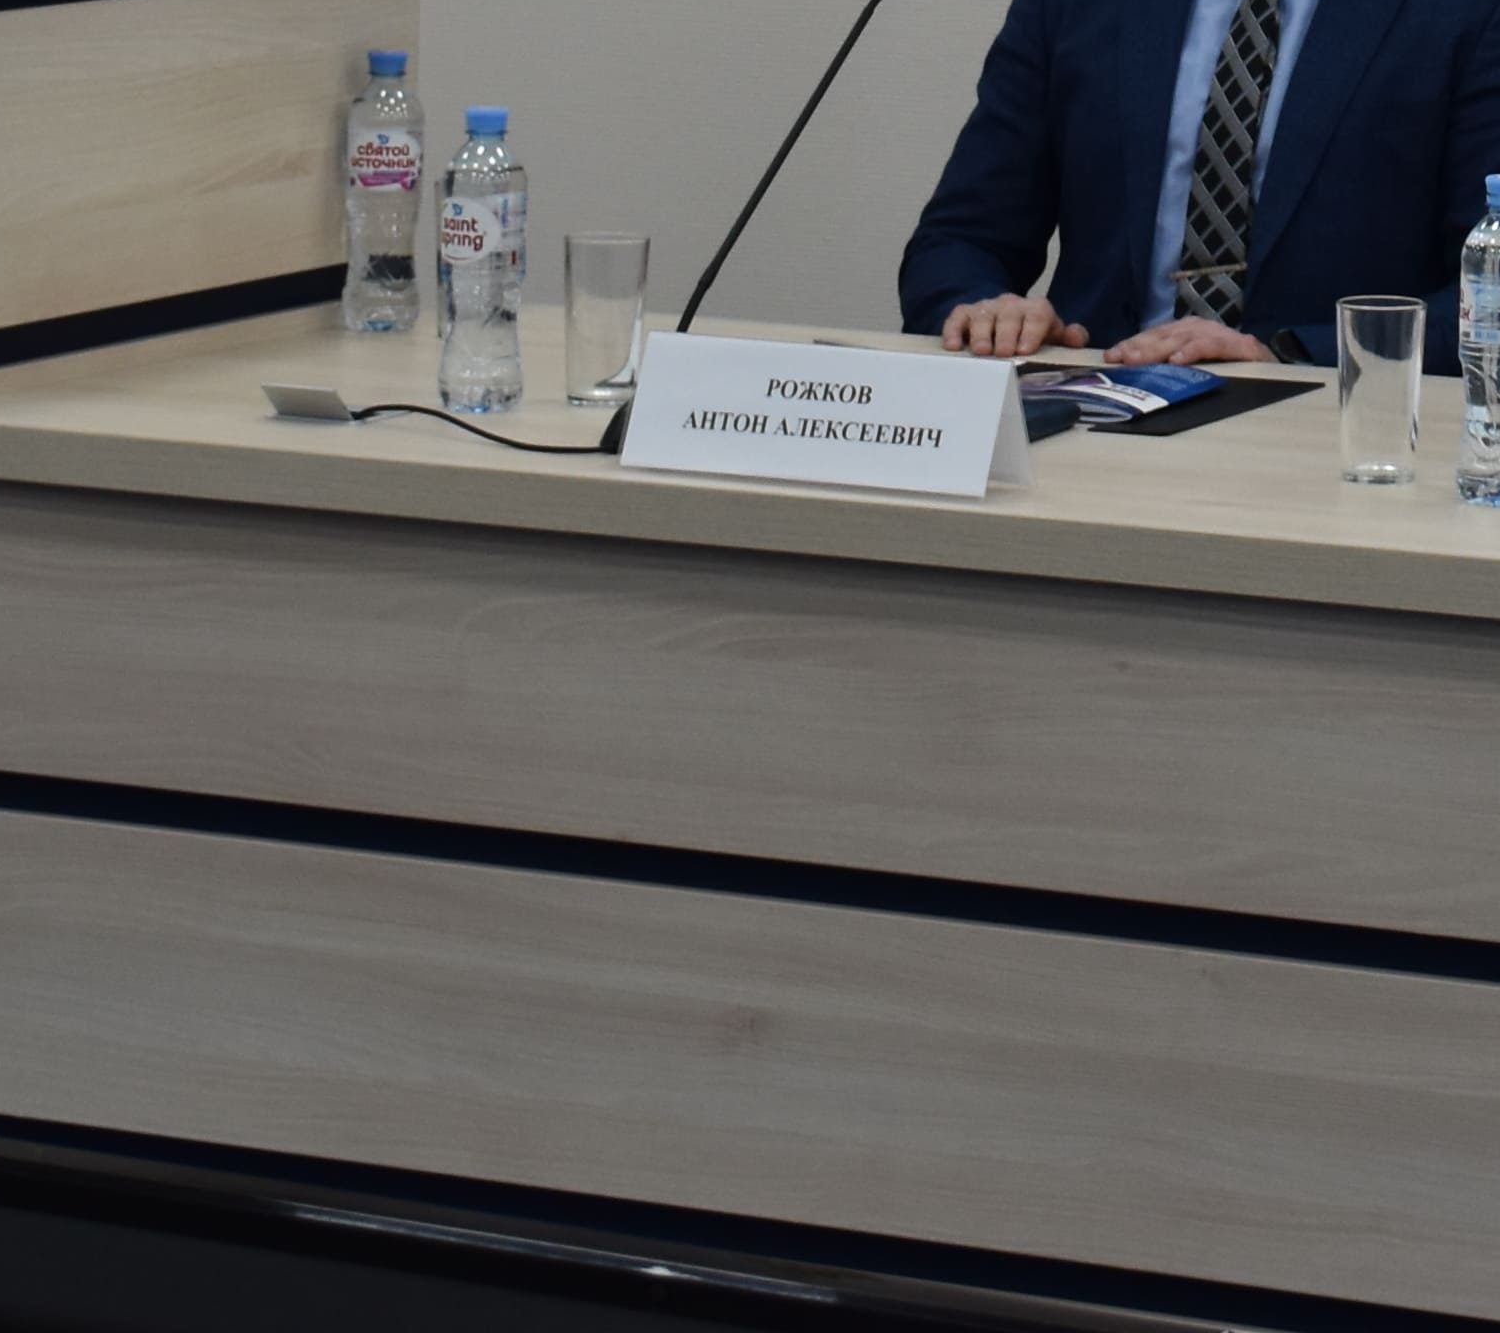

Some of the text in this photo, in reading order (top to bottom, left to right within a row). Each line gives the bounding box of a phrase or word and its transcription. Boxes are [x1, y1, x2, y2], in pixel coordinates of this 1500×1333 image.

[766, 378, 873, 405] РОЖКОВ
[682, 409, 943, 448] АНТОН АЛЕКСЕЕВИЧ
